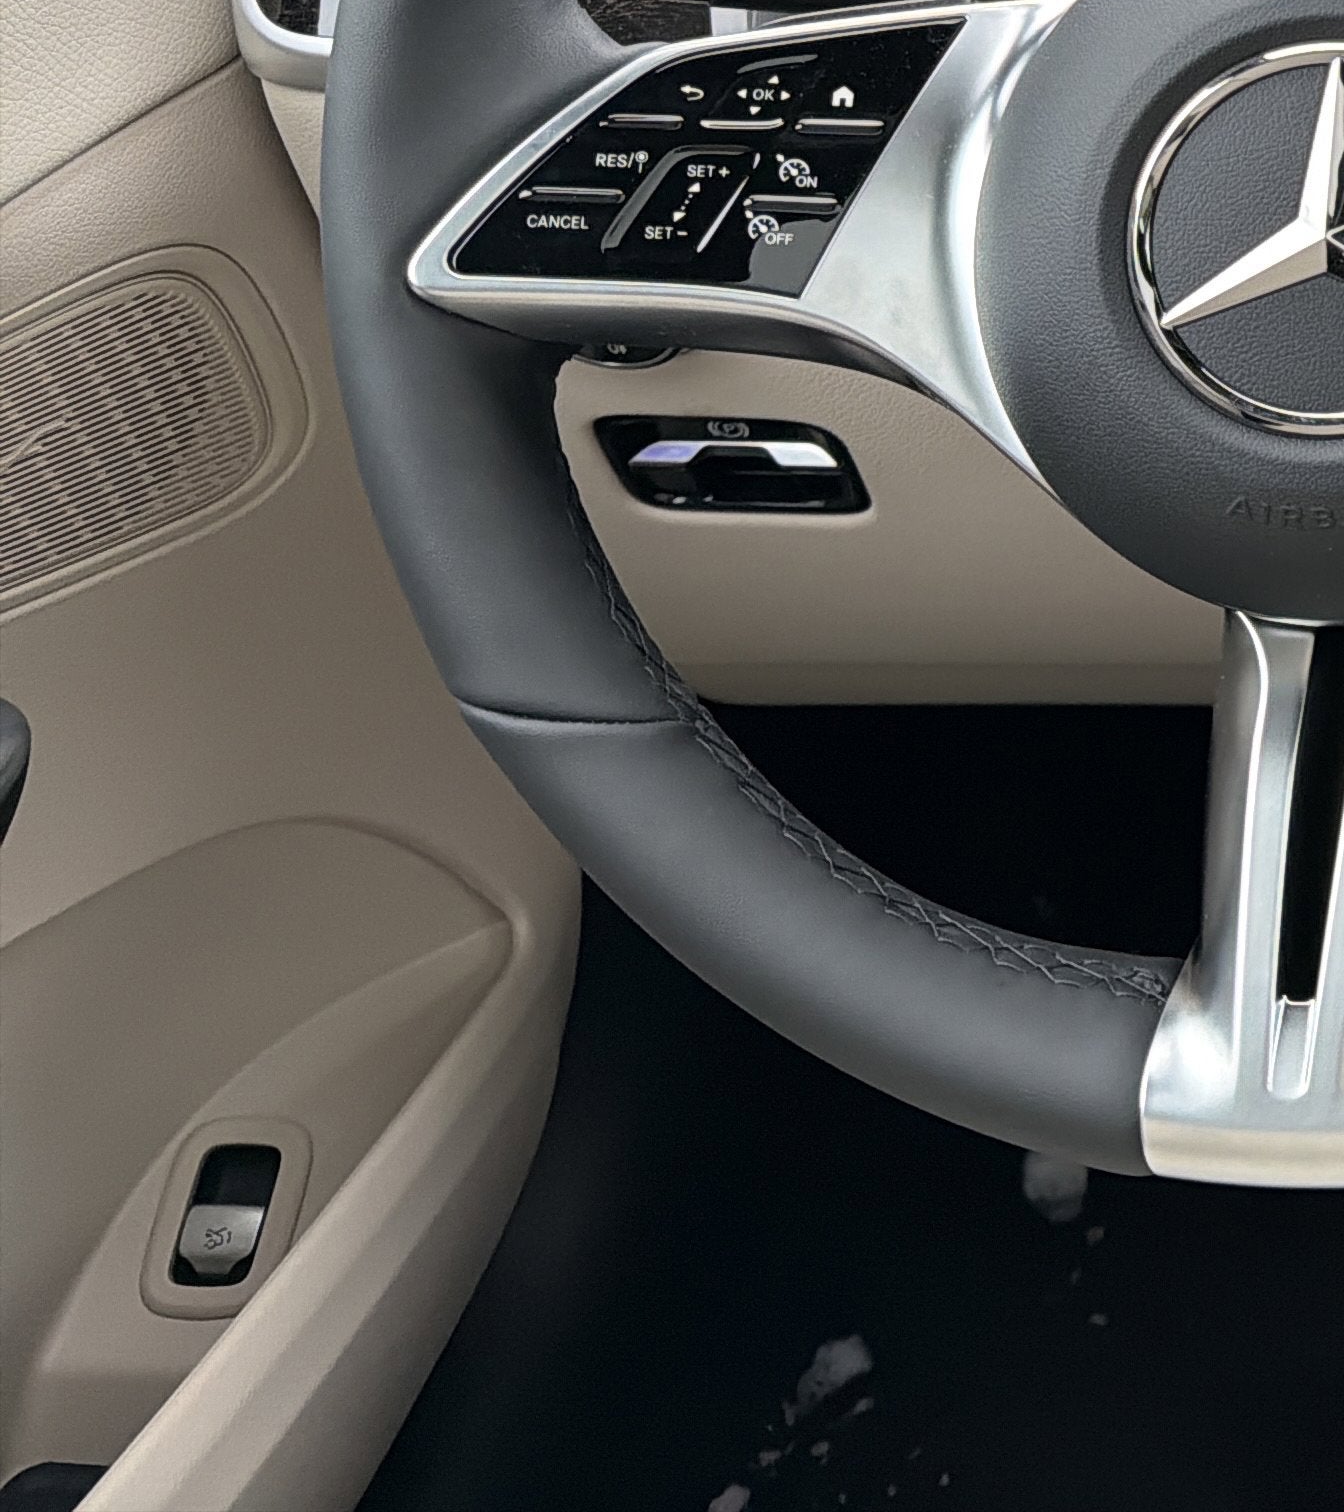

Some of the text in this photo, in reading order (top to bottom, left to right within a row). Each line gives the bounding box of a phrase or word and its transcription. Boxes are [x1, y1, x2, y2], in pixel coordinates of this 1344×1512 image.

[752, 88, 775, 102] OK
[795, 175, 818, 189] ON
[526, 214, 589, 231] CANCEL
[765, 231, 794, 246] OFF
